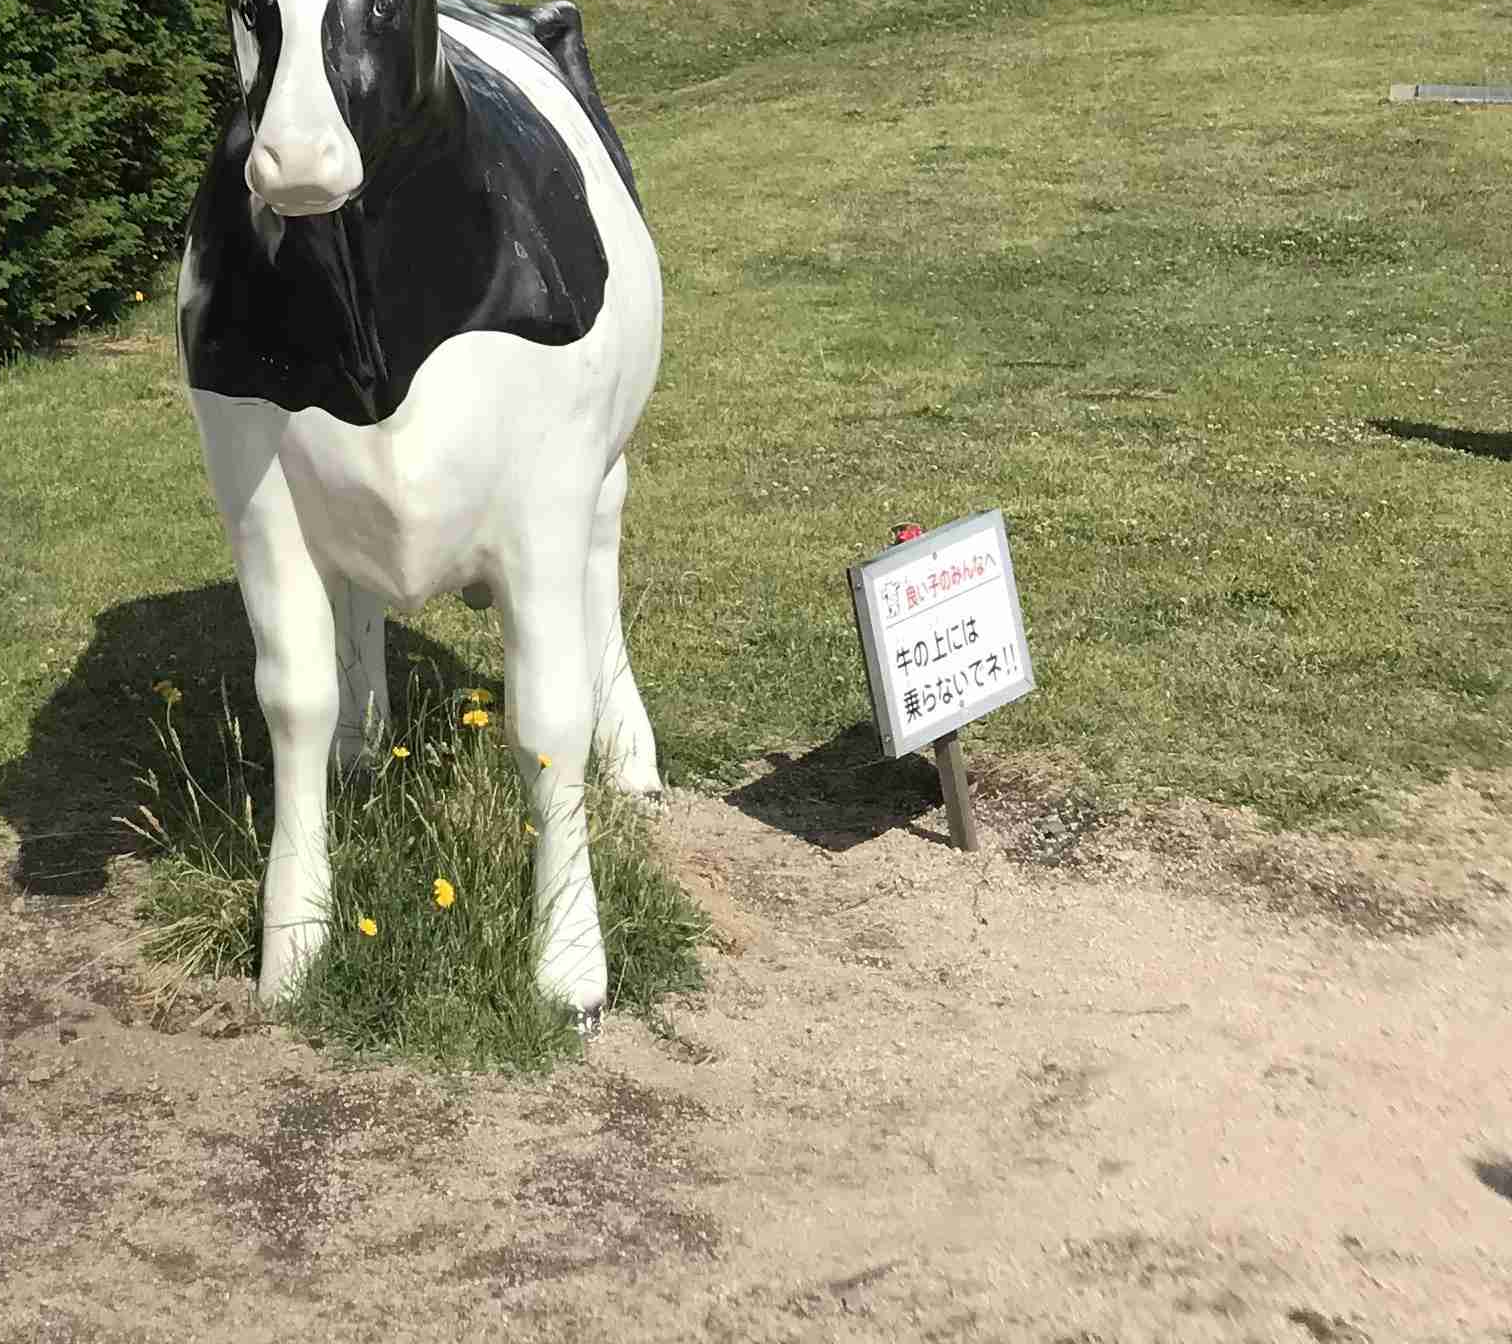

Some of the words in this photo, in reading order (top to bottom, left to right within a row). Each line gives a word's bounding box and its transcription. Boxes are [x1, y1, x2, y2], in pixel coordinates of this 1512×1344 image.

[896, 617, 978, 676] 牛の上には
